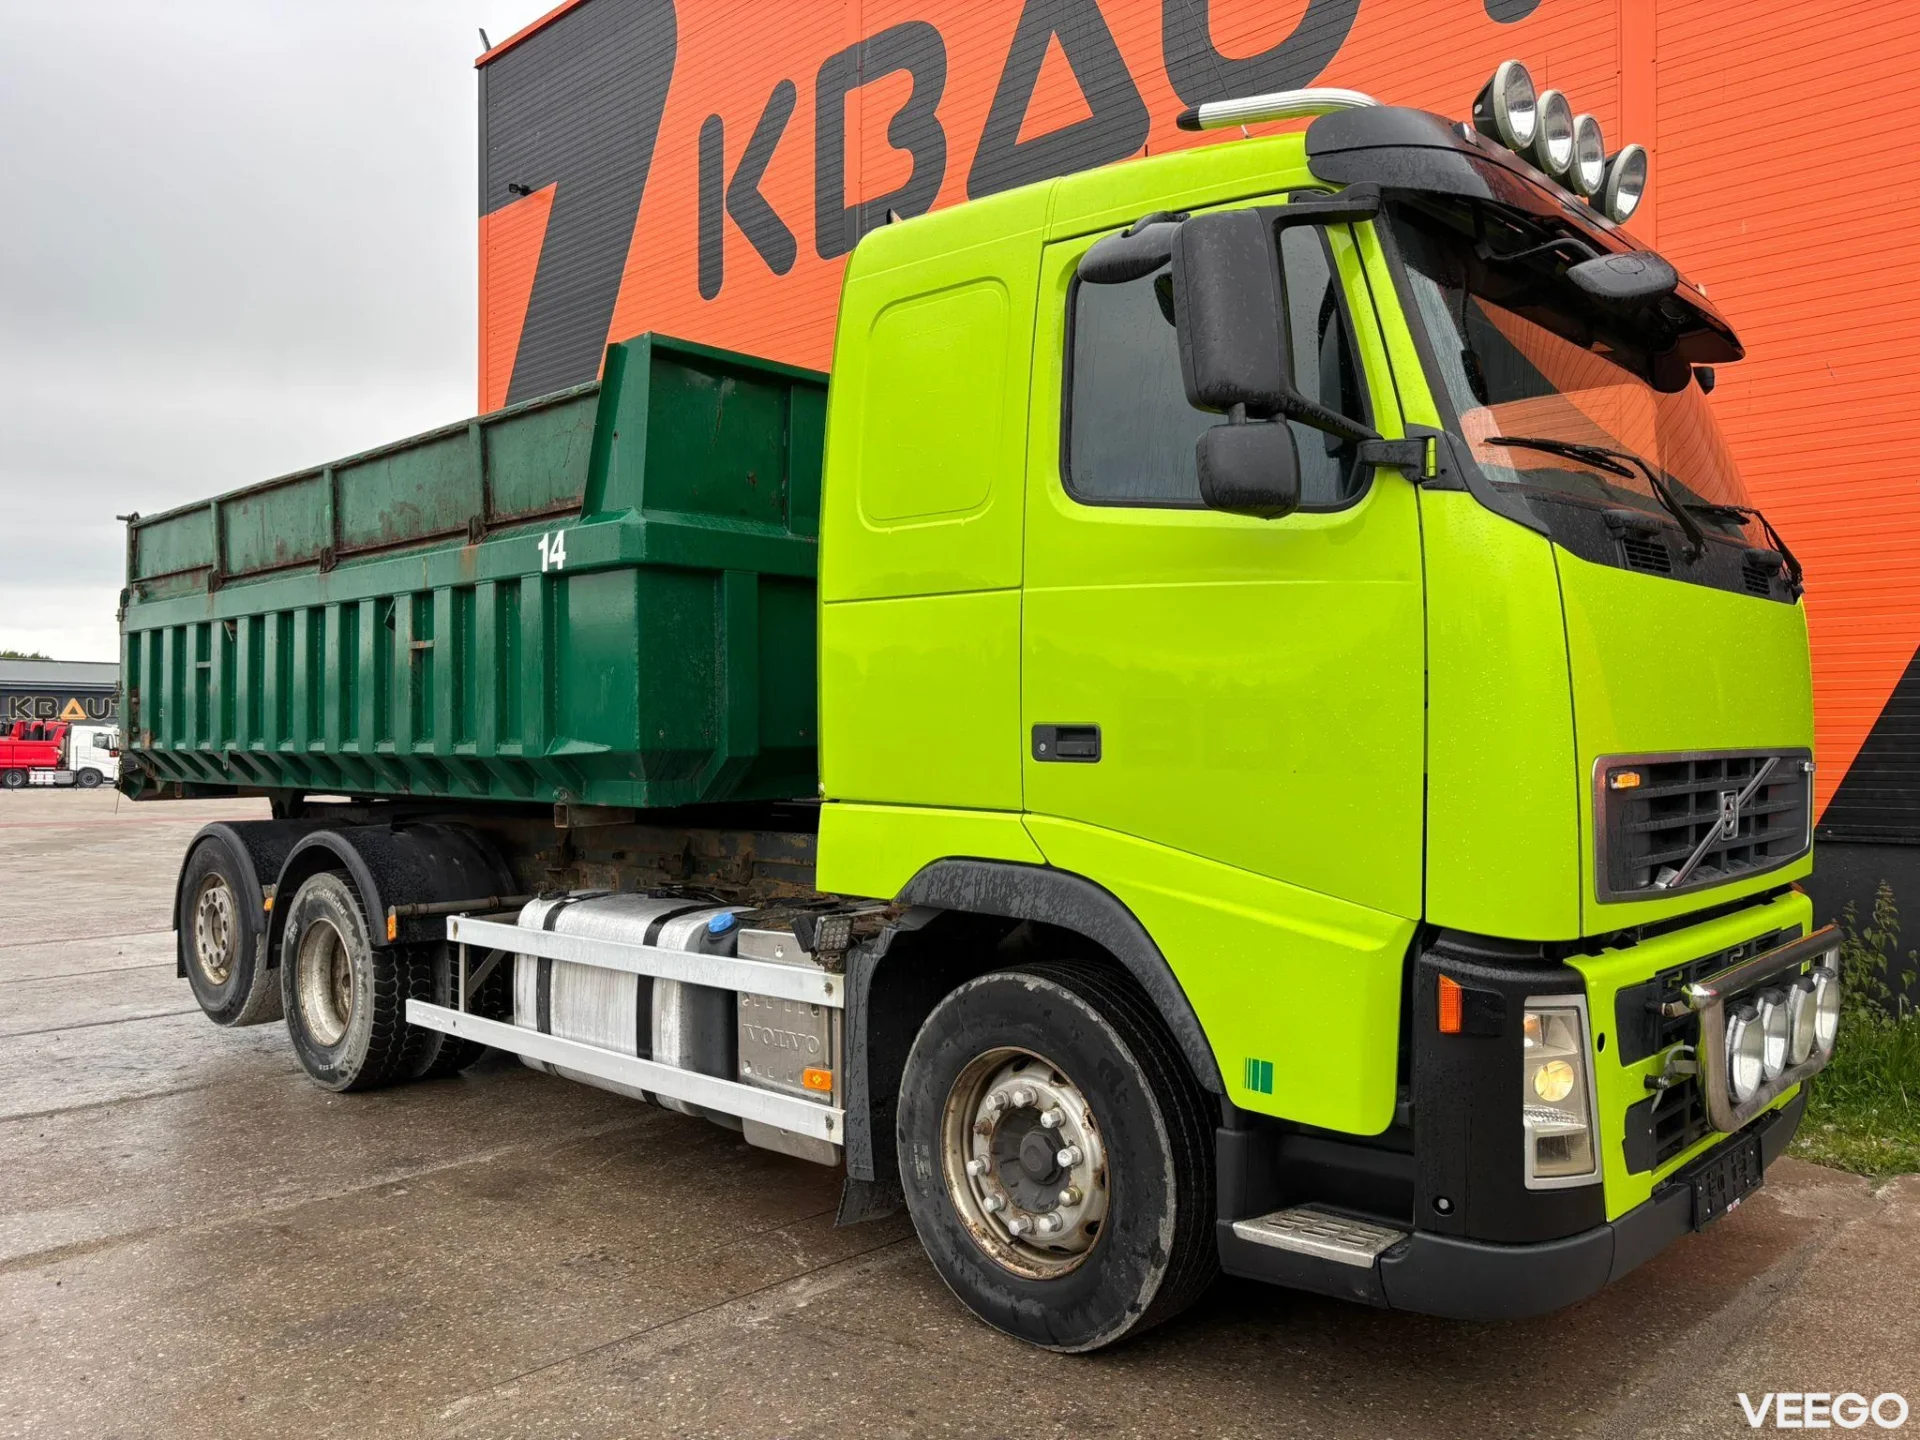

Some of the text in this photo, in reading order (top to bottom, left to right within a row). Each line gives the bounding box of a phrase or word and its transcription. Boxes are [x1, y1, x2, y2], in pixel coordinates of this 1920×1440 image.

[697, 0, 1541, 300] KBAU
[538, 529, 567, 573] 14
[743, 1023, 821, 1054] VOLVO
